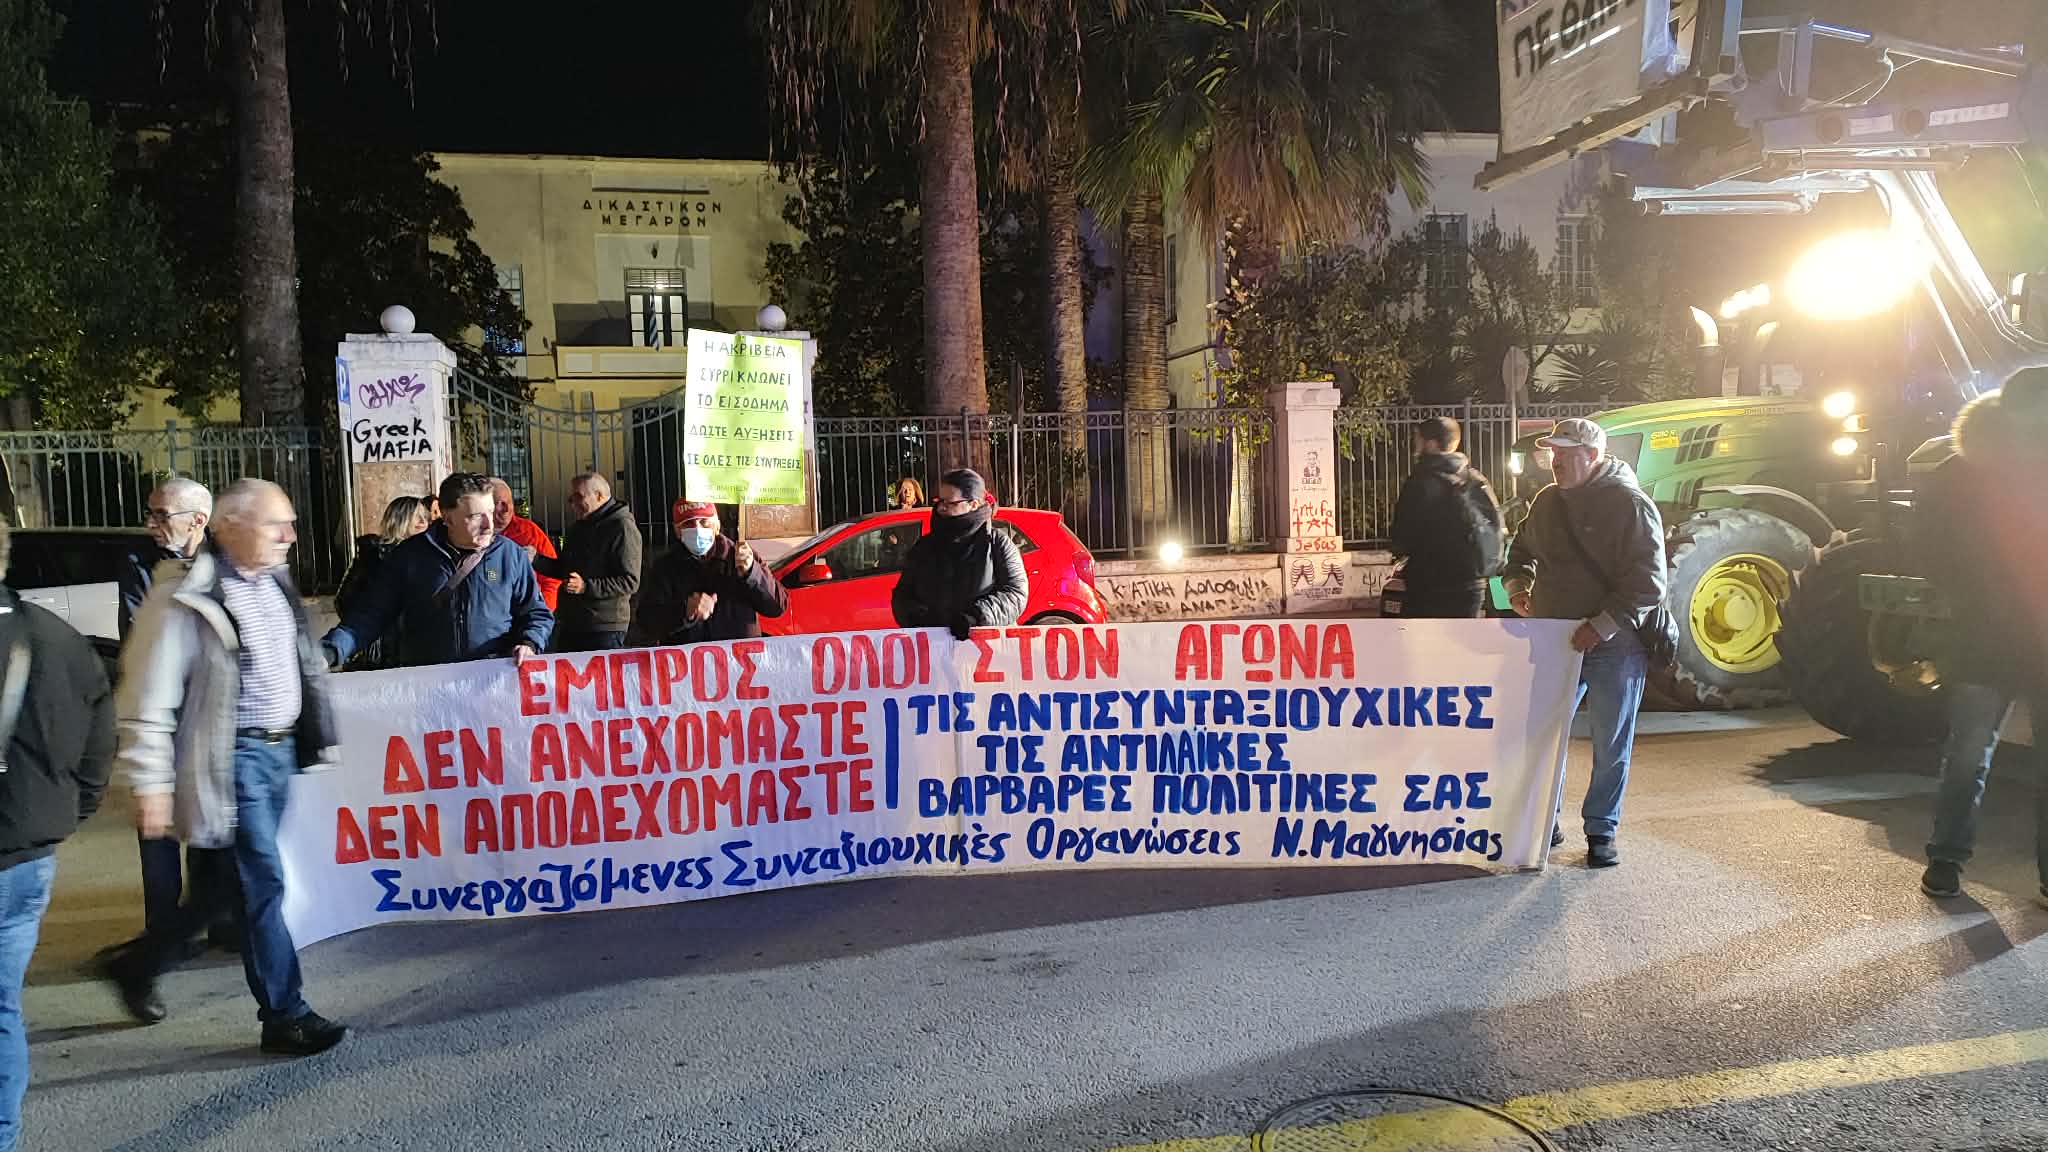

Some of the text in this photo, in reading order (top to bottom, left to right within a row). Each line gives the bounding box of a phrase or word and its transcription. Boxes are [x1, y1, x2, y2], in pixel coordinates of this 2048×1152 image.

[583, 200, 721, 213] ΔΙΚΑΣΤΙΚΟΝ
[602, 215, 706, 227] ΜΕΓΑΡΟΝ
[704, 340, 786, 358] Η ΑΚΡΙΒΕΙΑ
[700, 368, 791, 385] ΣΥΡΡΙΚΝΩΝΕΙ
[697, 393, 790, 412] ΤΟ ΕΙΣΟΔΗΜΑ
[353, 418, 426, 443] Greek
[689, 424, 795, 442] ΔΩΣΤΕ ΑΥΞΗΣΕΙΣ
[364, 439, 432, 462] MAFIA
[687, 453, 700, 465] ΣΕ
[703, 454, 732, 467] ΟΛΕΣ
[736, 455, 751, 466] ΤΙΣ
[518, 624, 1354, 716] ΕΜΠΡΟΣ ΟΛΟΙ ΣΤΟΝ ΑΓΩΝΑ
[908, 686, 1493, 734] ΤΙΣ ΑΝΤΙΣΥΝΤΑΞΙΟΥΧΙΚΕΣ
[383, 701, 869, 794] ΔΕΝ ΑΝΕΧΟΜΑΣΤΕ
[977, 734, 1044, 773] ΤΙΣ
[919, 772, 1491, 817] ΒΑΡΒΑΡΕΣ ΠΟΛΙΤΙΚΕΣ ΣΑΣ
[335, 759, 875, 864] ΔΕΝ ΑΠΟΔΕΧΟΜΑΣΤΕ
[371, 857, 713, 916] Συνεργαζόμενες
